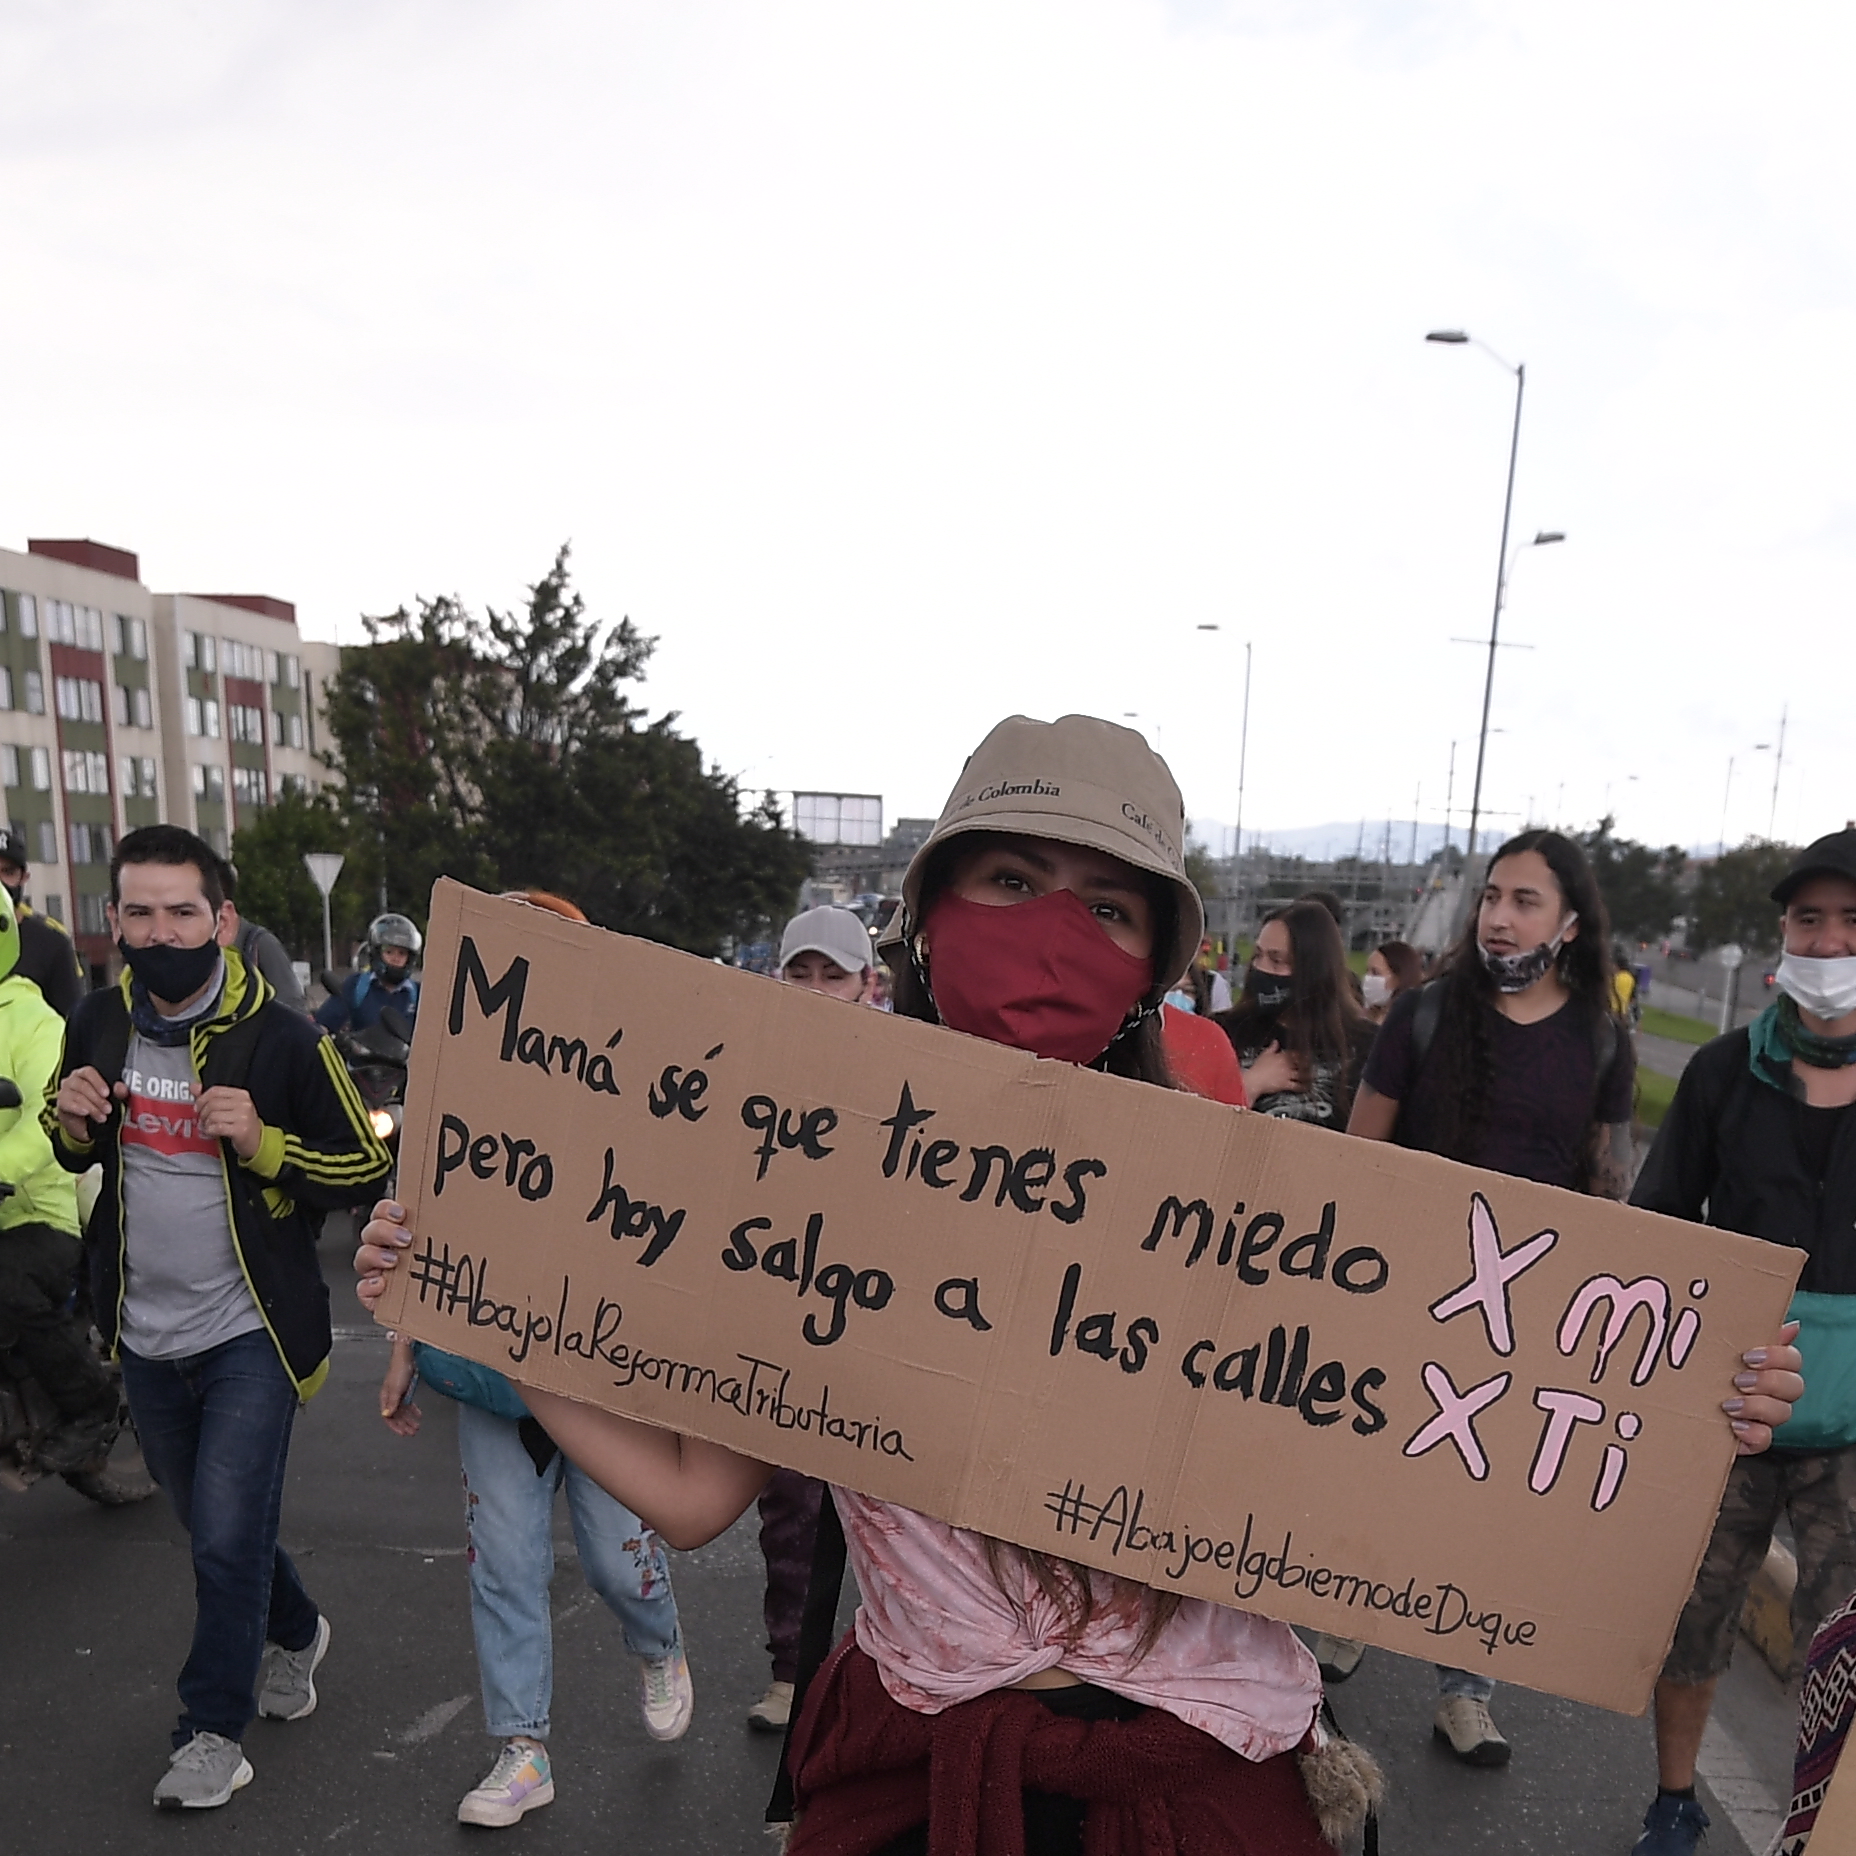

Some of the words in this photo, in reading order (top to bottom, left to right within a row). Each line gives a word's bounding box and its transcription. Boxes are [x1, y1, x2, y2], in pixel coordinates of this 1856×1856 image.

[978, 779, 1060, 802] Colombia
[448, 936, 620, 1096] Mamá
[648, 1043, 724, 1122] sé
[742, 1094, 838, 1181] que
[880, 1080, 1107, 1224] tienes
[1142, 1196, 1389, 1294] miedo
[1429, 1192, 1559, 1357] X
[587, 1147, 686, 1267] hoy
[935, 1275, 992, 1331] a
[1050, 1264, 1158, 1375] las
[1181, 1325, 1388, 1436] calles
[1402, 1362, 1512, 1481] X
